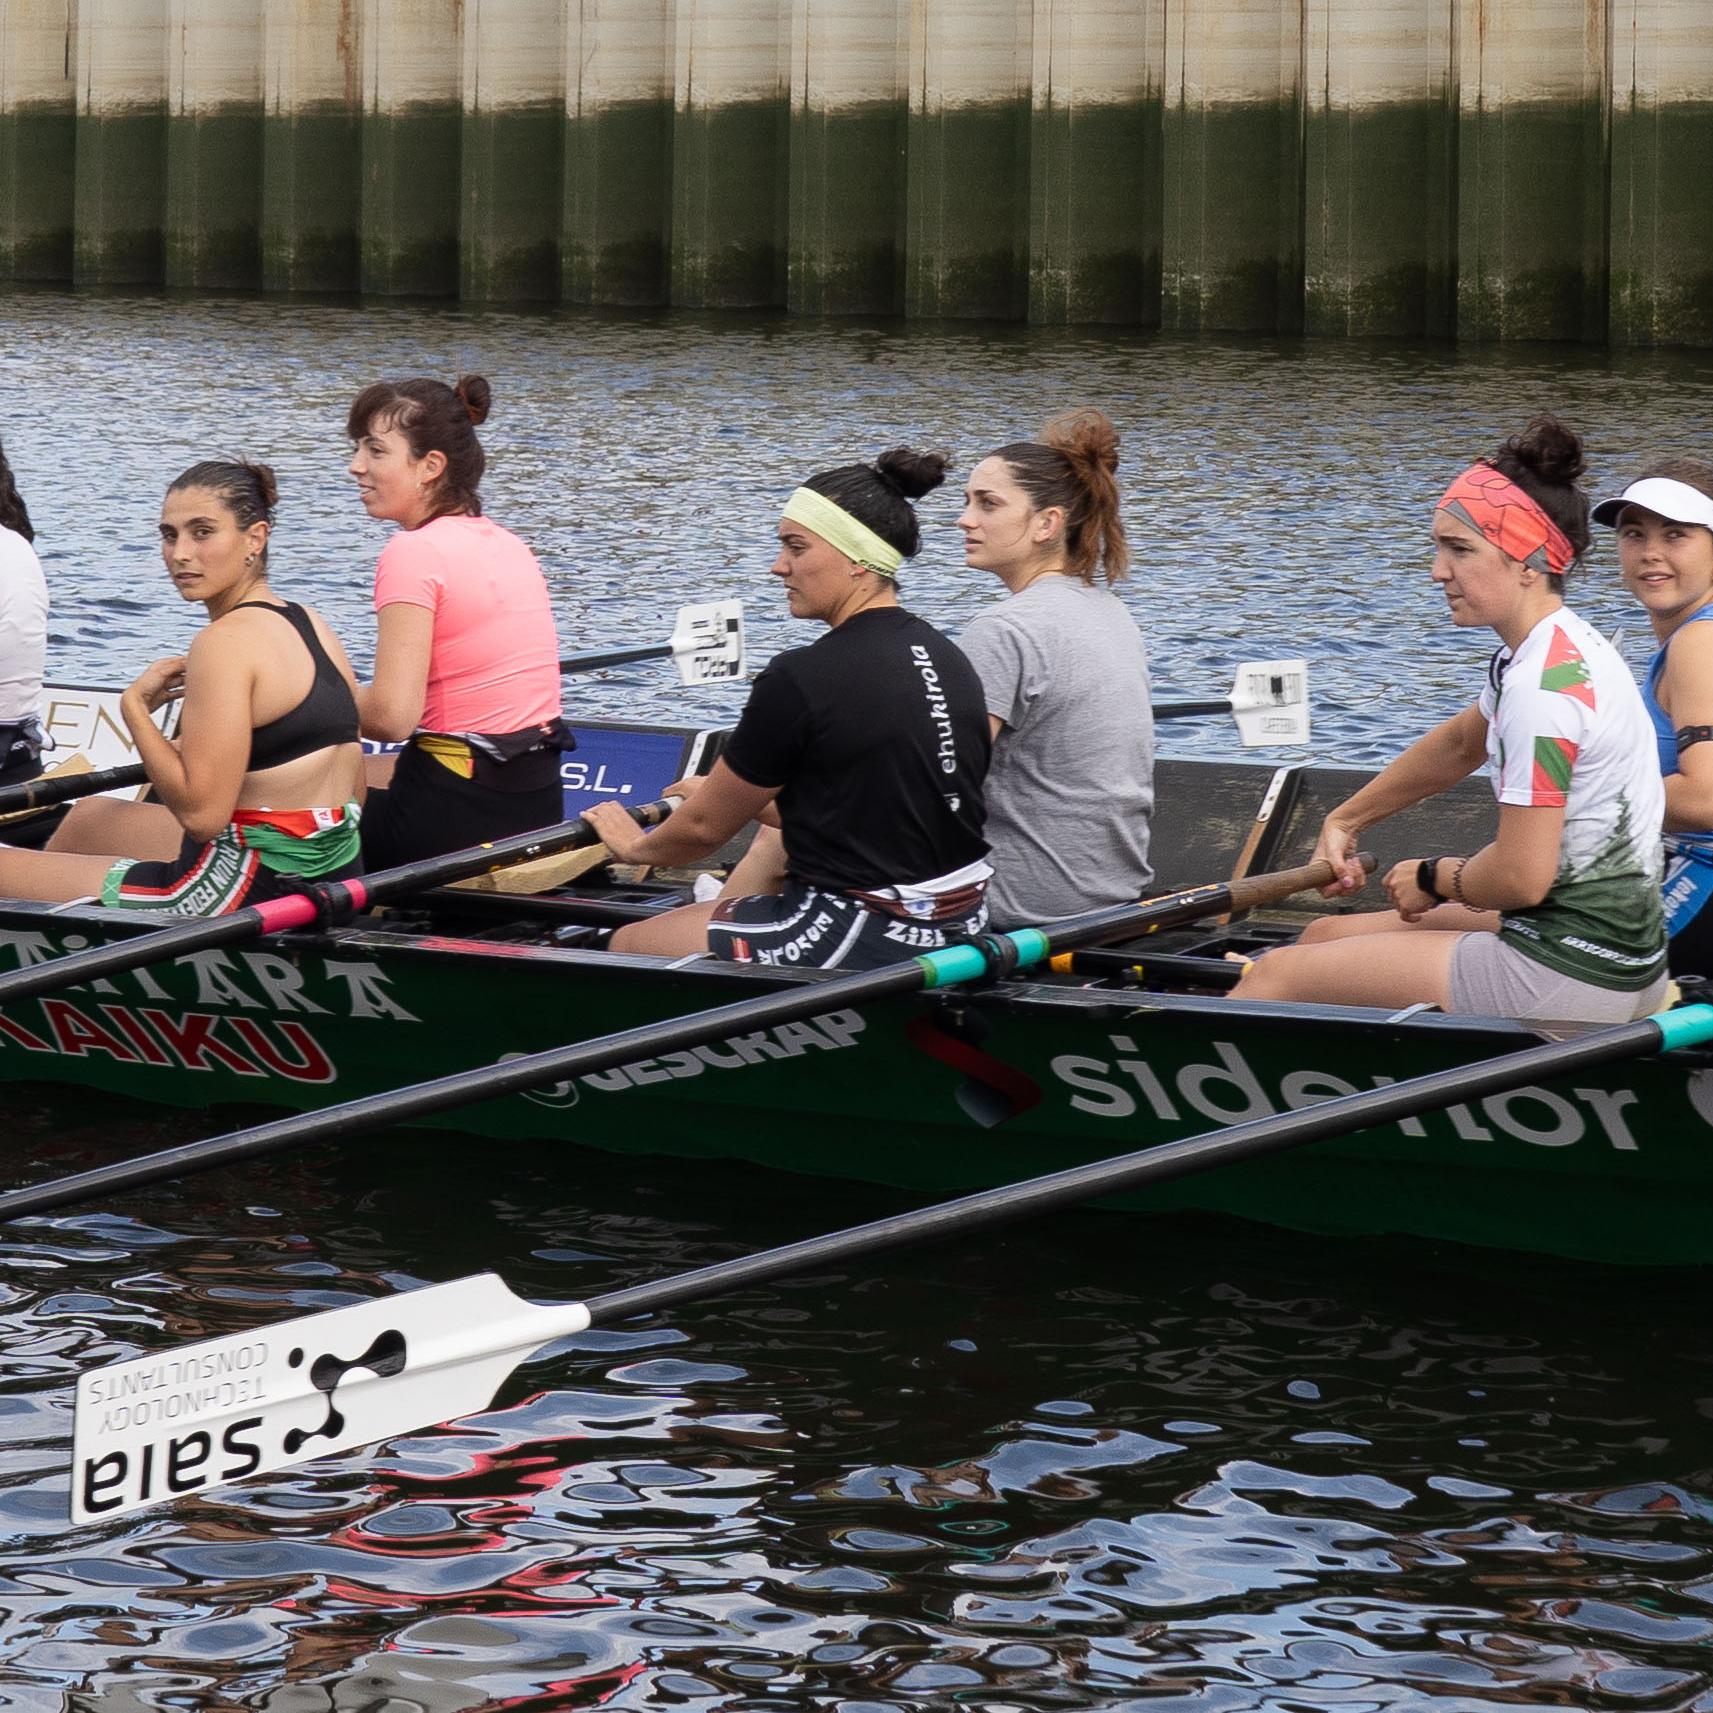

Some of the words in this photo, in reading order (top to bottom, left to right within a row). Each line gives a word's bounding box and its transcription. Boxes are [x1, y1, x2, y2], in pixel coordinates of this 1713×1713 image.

[910, 645, 957, 774] ehukirola
[560, 762, 633, 794] S.L.
[87, 1343, 269, 1404] CONSULTANTS
[97, 1376, 266, 1434] TECHNOLOGY
